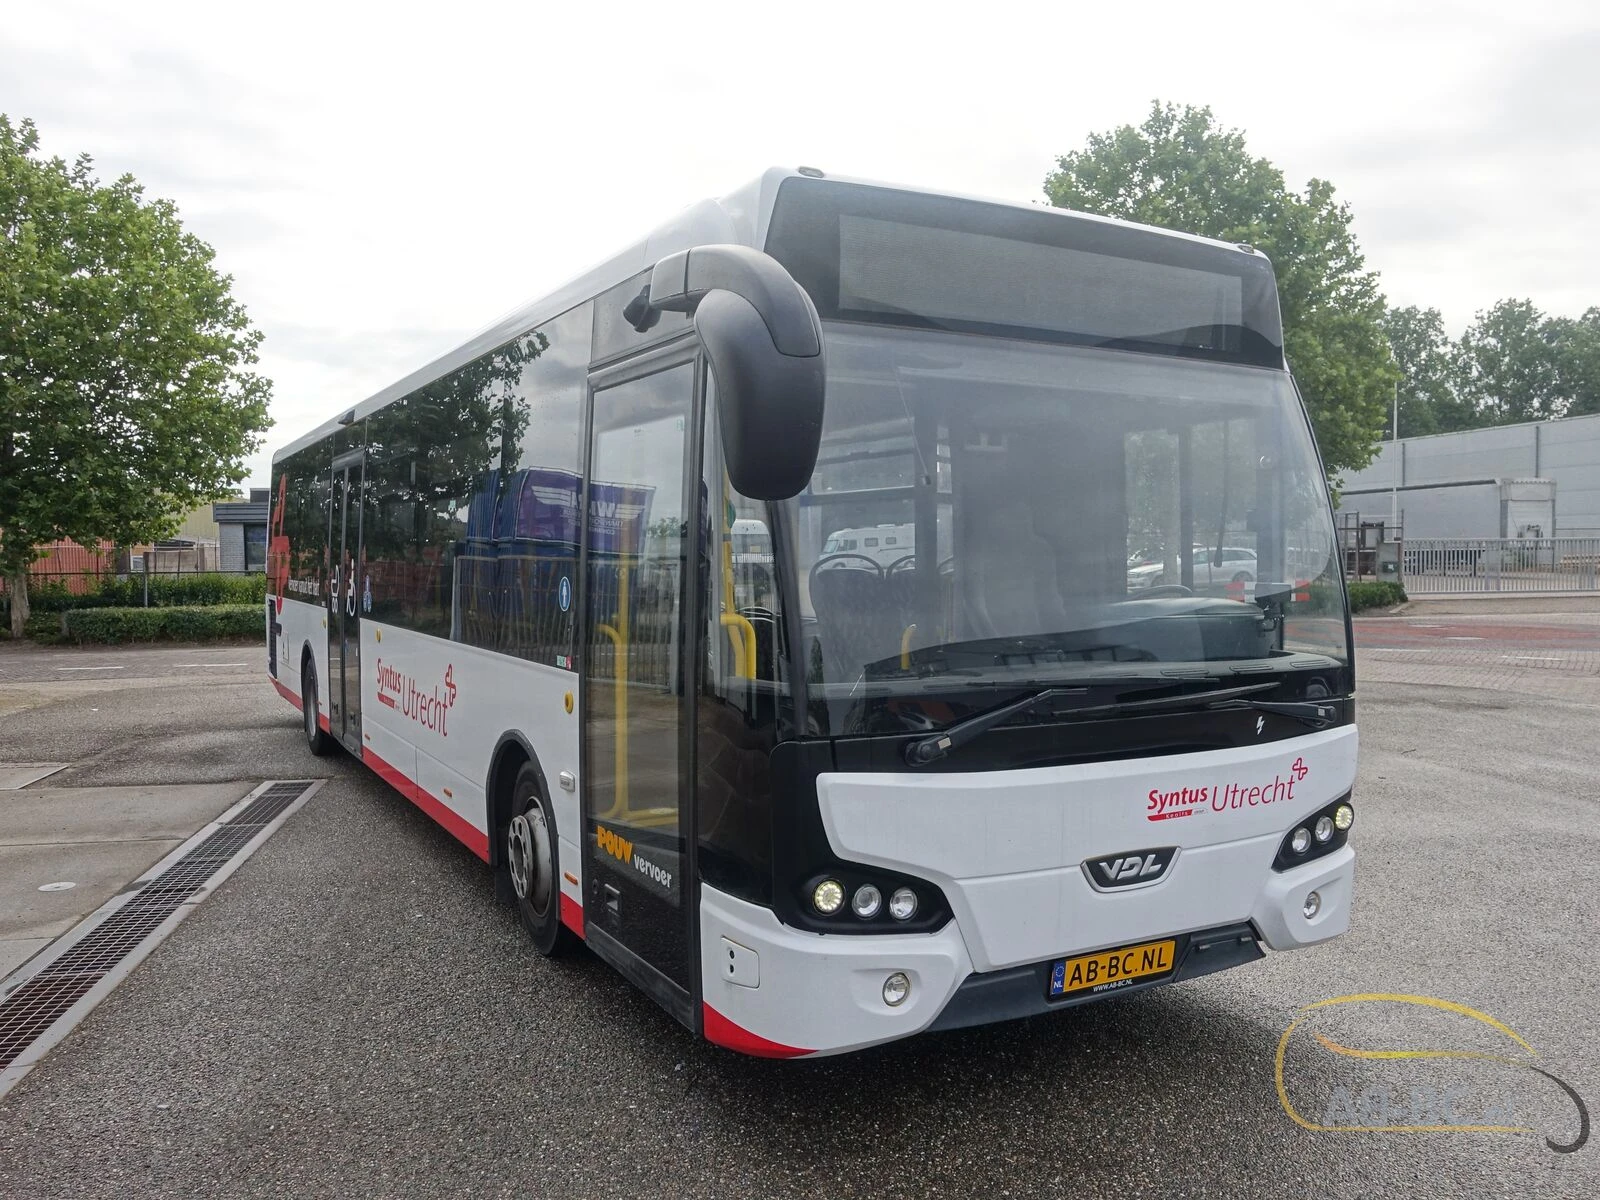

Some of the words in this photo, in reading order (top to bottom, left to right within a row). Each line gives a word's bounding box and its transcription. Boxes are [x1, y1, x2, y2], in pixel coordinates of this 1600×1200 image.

[377, 658, 401, 694] Syntus
[402, 675, 448, 737] Utrecht
[1147, 786, 1208, 813] Syntus
[1211, 775, 1295, 812] Utrecht
[596, 824, 633, 865] POUW
[633, 853, 672, 888] vervoer
[1098, 854, 1162, 881] VDL
[1053, 980, 1063, 989] NL
[1068, 946, 1167, 987] AB-BC.NL
